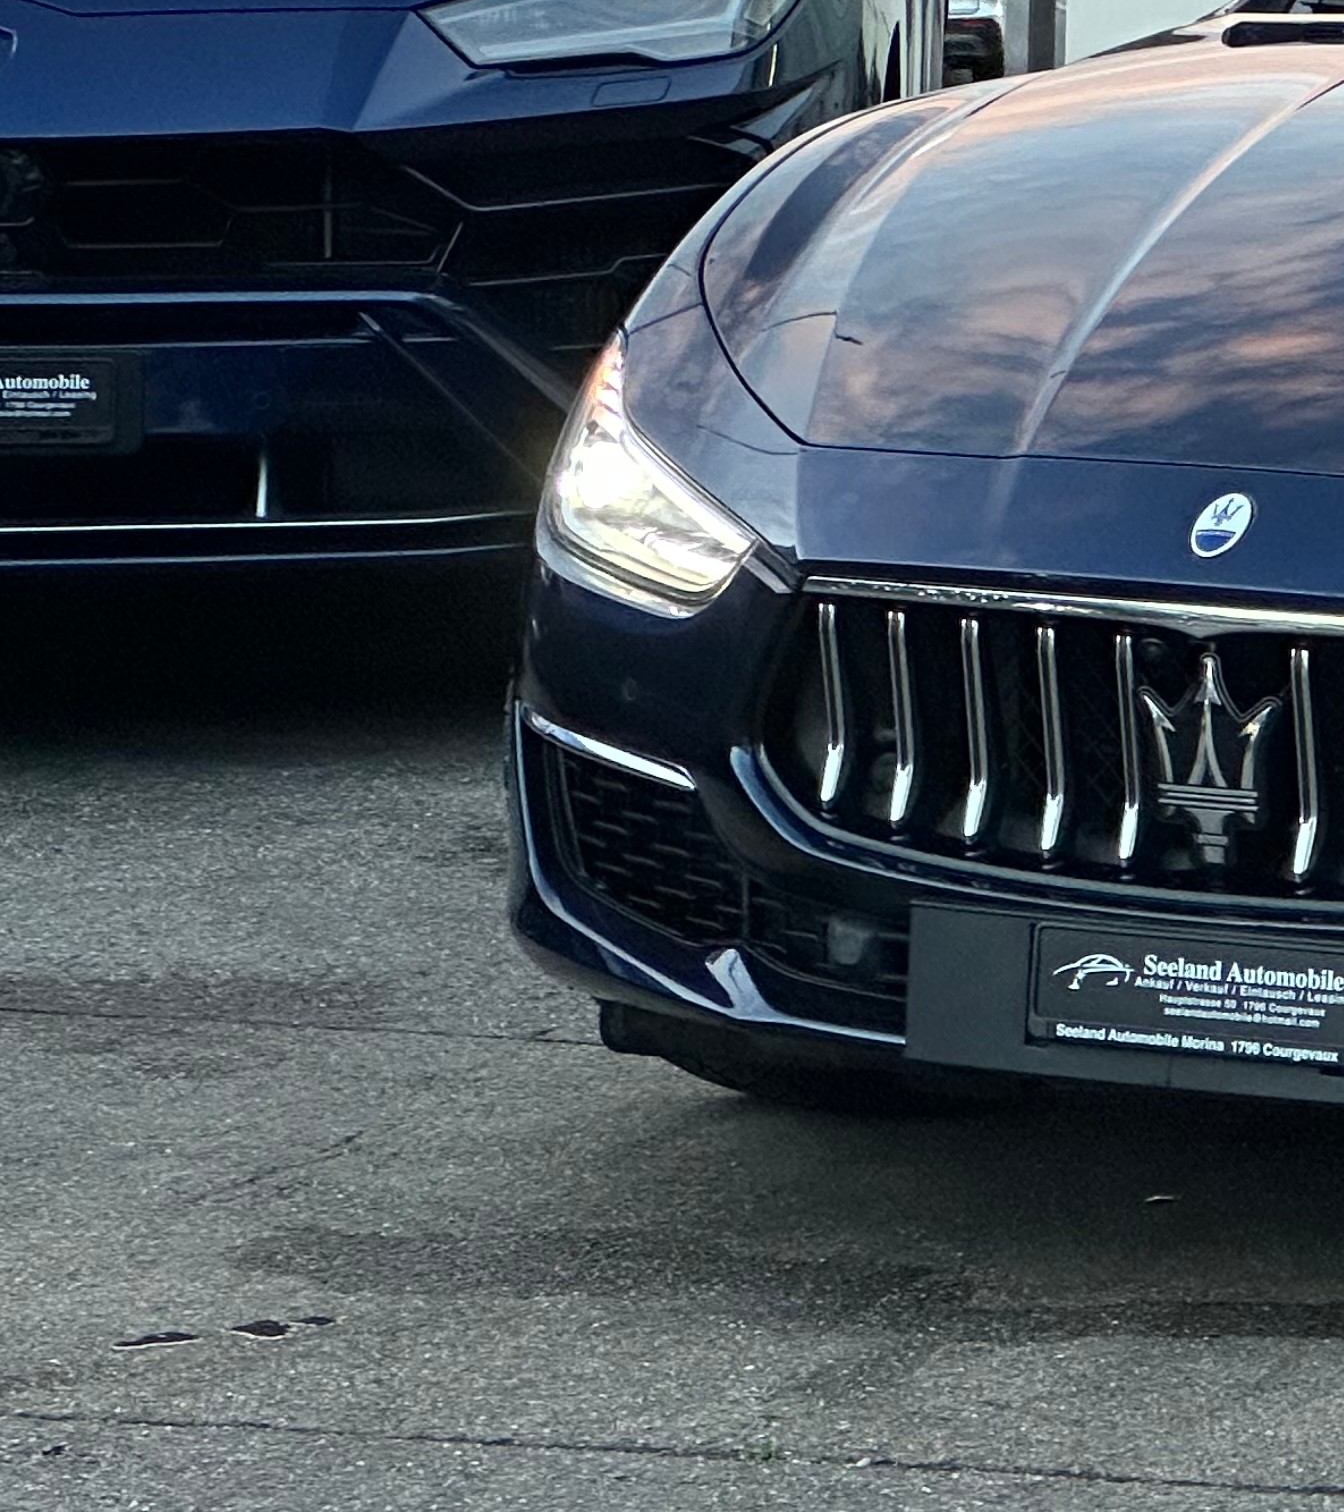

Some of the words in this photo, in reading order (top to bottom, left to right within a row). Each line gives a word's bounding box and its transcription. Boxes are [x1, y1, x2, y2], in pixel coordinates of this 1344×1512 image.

[1143, 954, 1222, 981] Seeland
[1226, 961, 1344, 992] Automobile
[1056, 1023, 1106, 1041] Seeland
[1107, 1029, 1180, 1048] Automobile
[1181, 1035, 1225, 1052] Morina
[1231, 1040, 1262, 1055] 1796
[1263, 1043, 1339, 1063] Courgevaux
